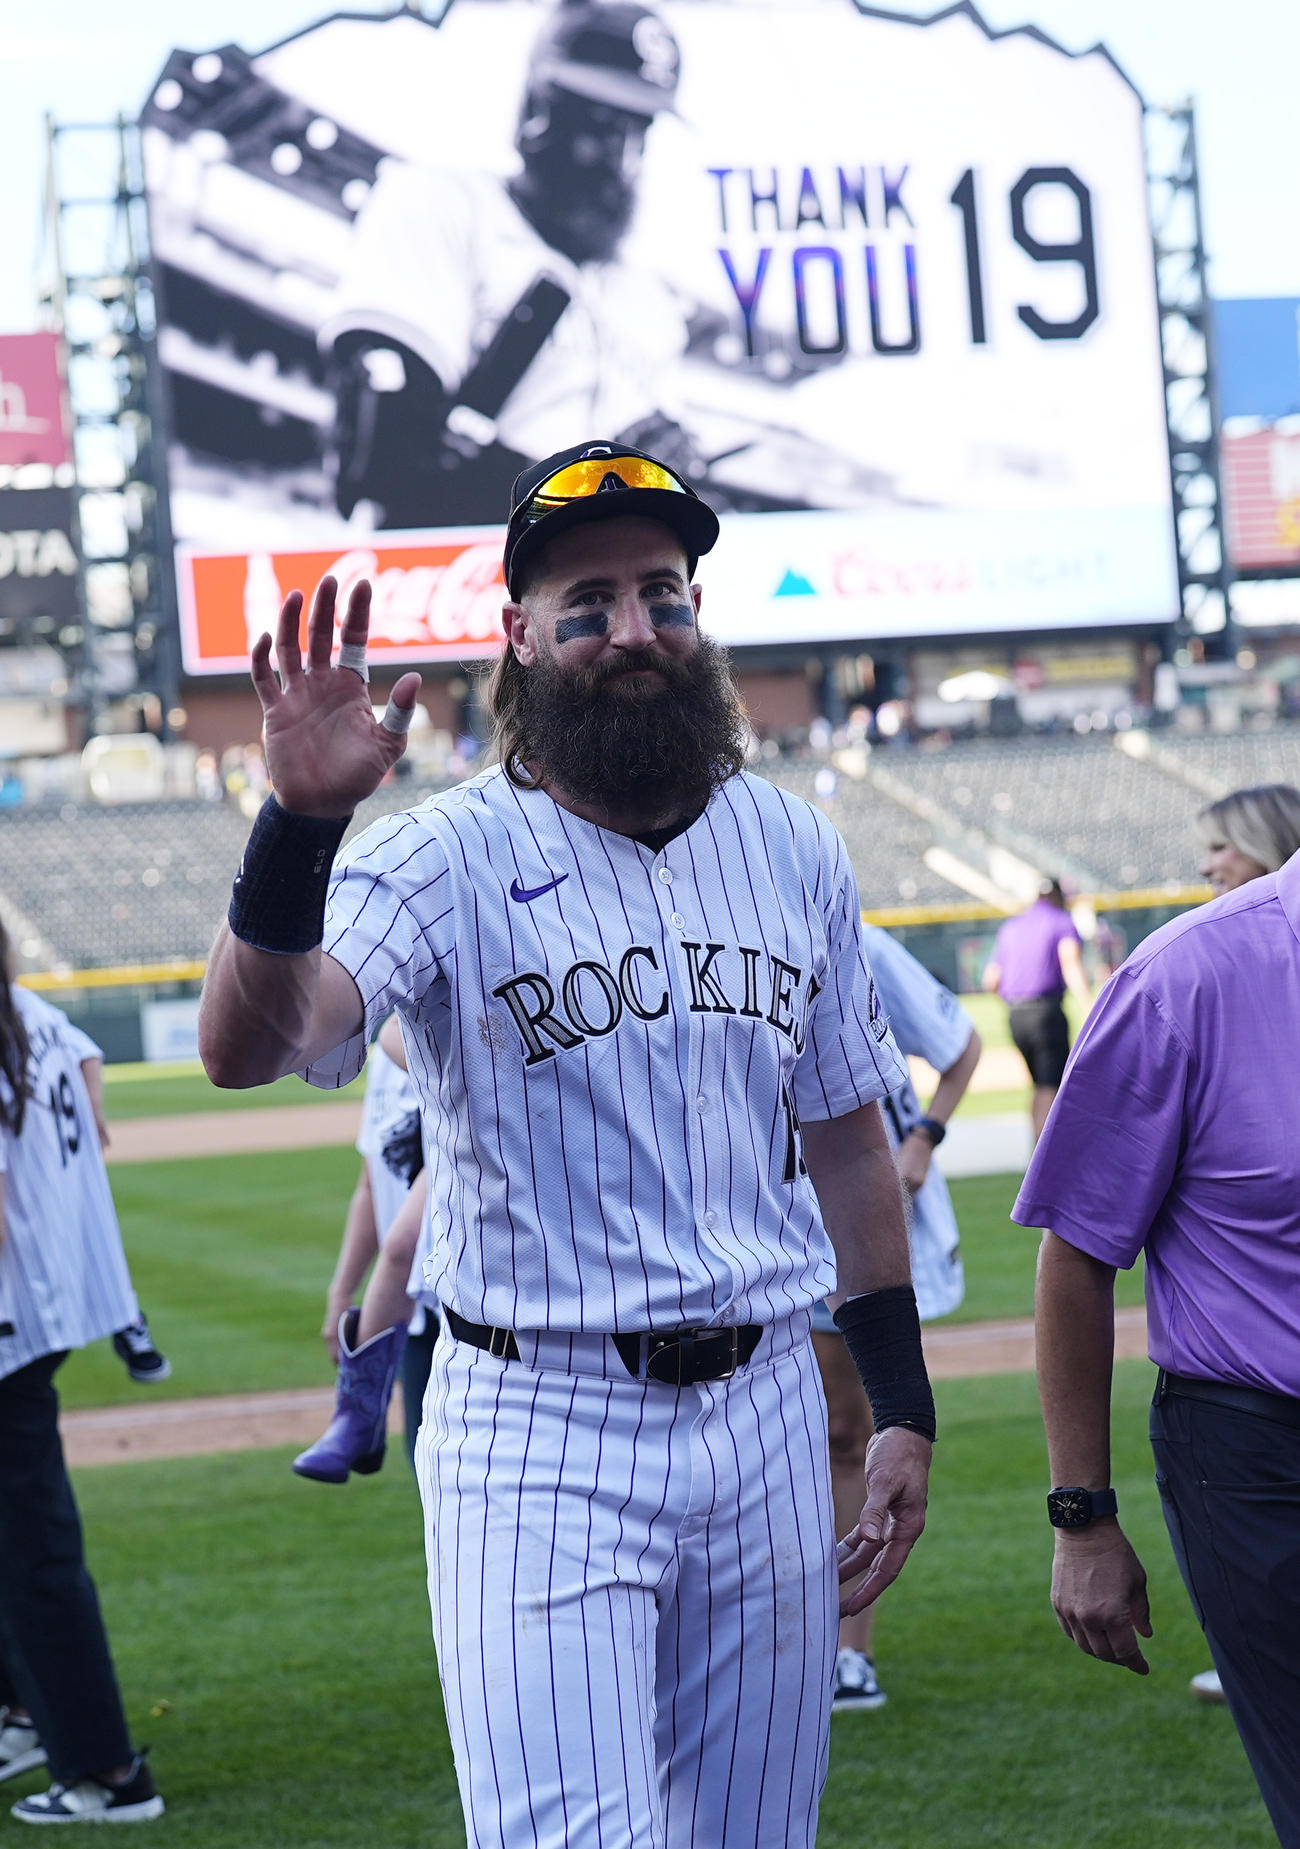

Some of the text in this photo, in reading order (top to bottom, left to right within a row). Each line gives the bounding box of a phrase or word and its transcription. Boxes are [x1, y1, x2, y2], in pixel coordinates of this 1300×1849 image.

[707, 164, 915, 232] THANK
[717, 244, 921, 357] YOU
[950, 166, 1100, 345] 19
[50, 1072, 81, 1170] 19
